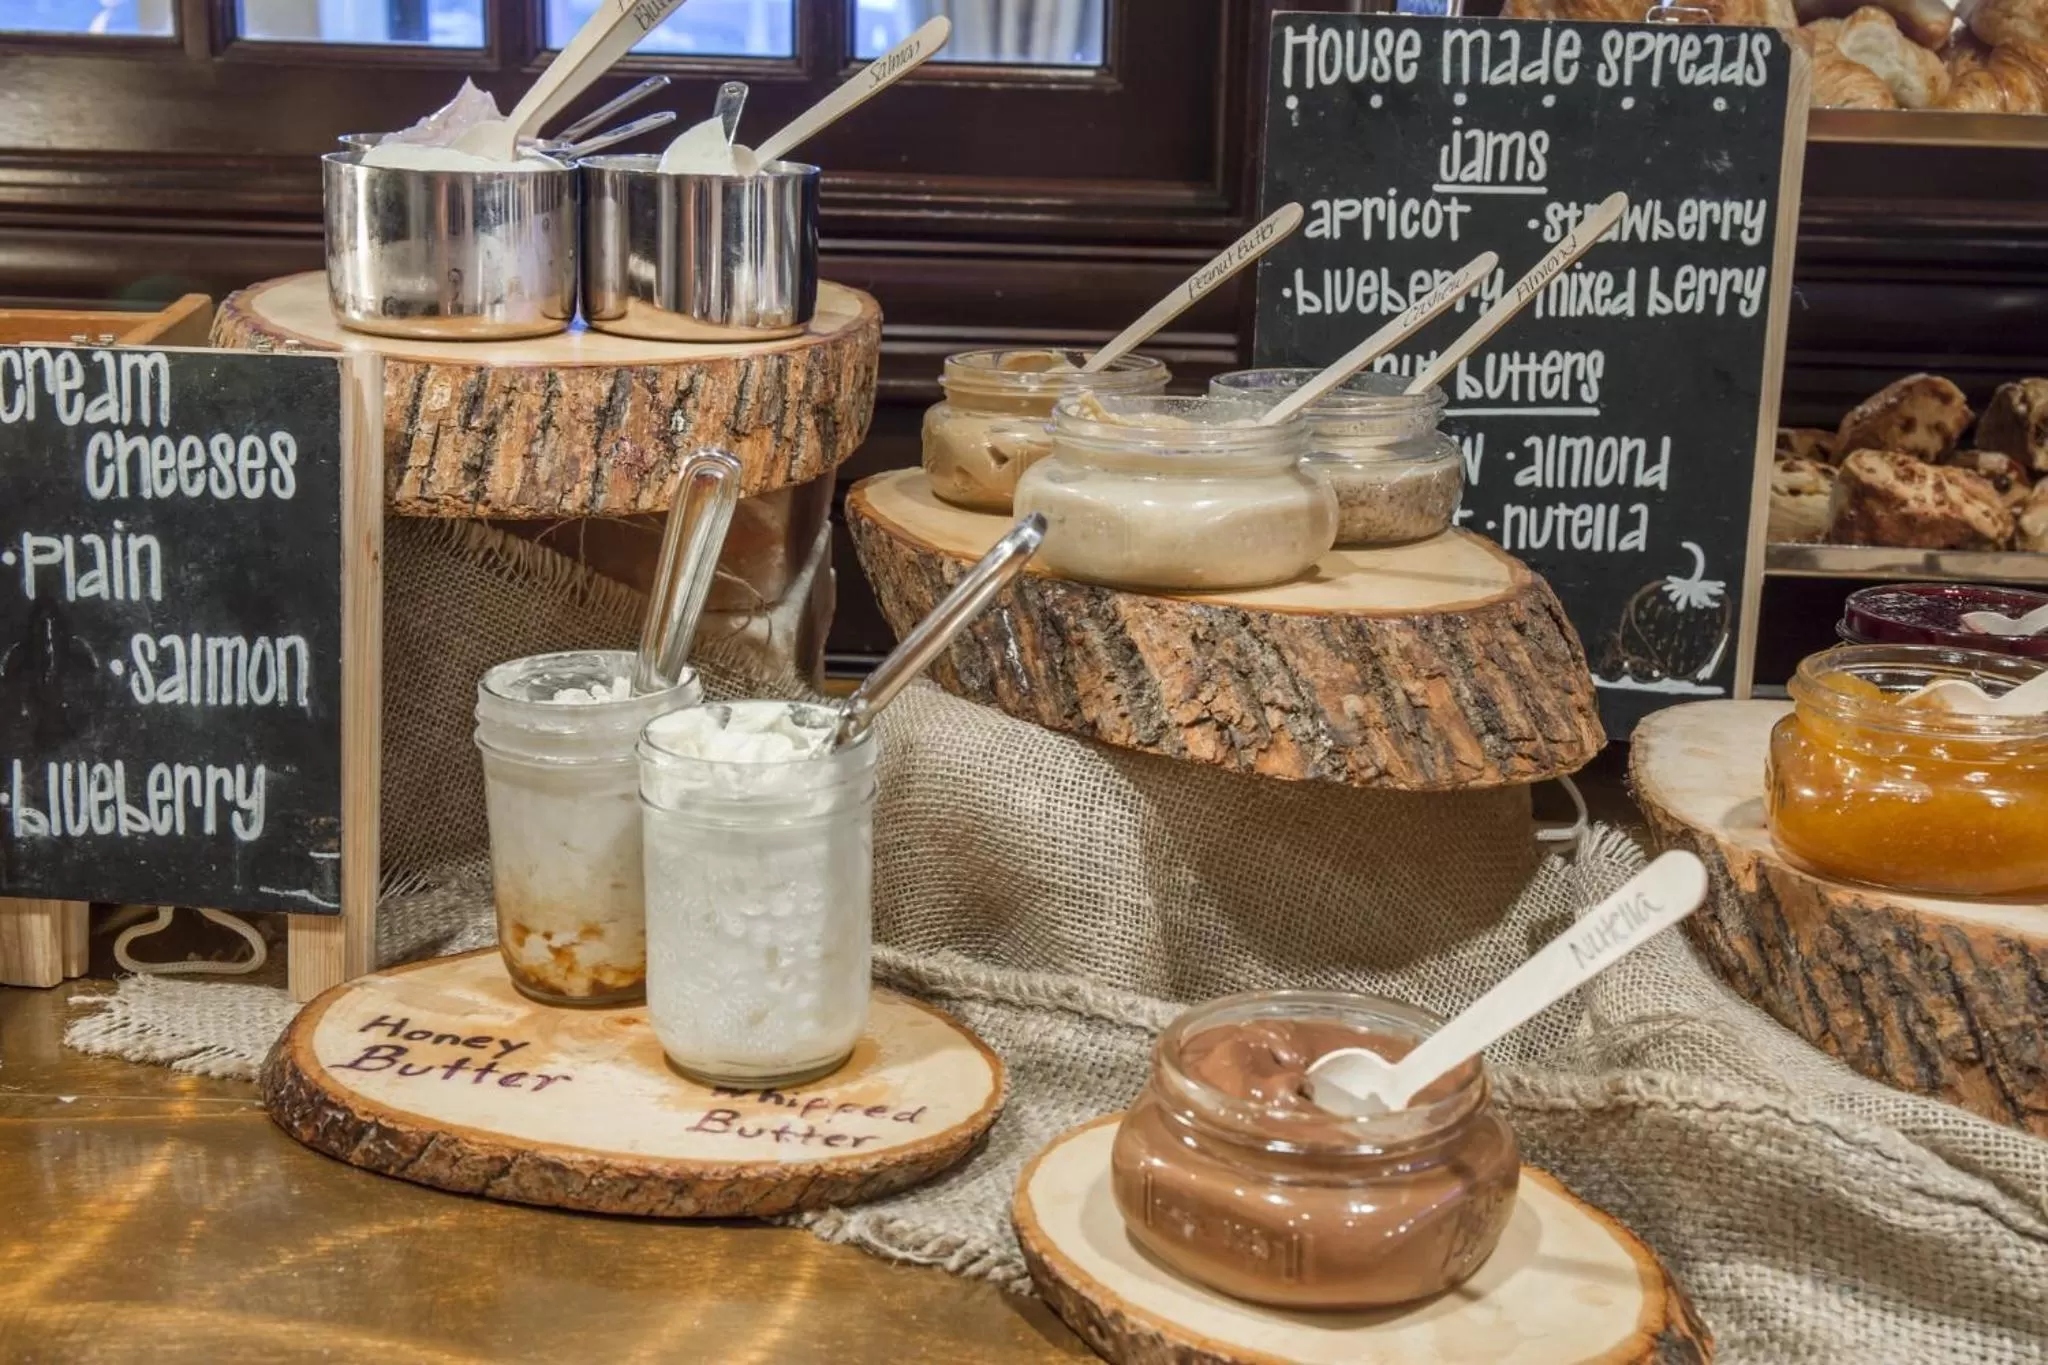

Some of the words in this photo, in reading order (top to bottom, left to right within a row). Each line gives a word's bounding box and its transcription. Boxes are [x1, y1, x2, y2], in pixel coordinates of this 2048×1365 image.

[1283, 25, 1422, 90] House
[1443, 20, 1582, 87] made
[1597, 28, 1772, 90] spreads
[1439, 116, 1550, 184] jams
[1303, 187, 1471, 242] apricot
[1188, 252, 1233, 299] Peanut
[1535, 261, 1637, 320] mixed
[1647, 265, 1767, 319] berry
[0, 347, 171, 428] cream
[1456, 348, 1605, 405] butters
[85, 429, 298, 500] cheeses
[1514, 435, 1672, 491] almond
[1502, 502, 1649, 552] nutella
[131, 632, 310, 708] salmon
[13, 758, 267, 842] blueberry
[358, 1013, 531, 1059] Honey
[328, 1044, 574, 1093] Butter
[687, 1108, 881, 1150] Butter
